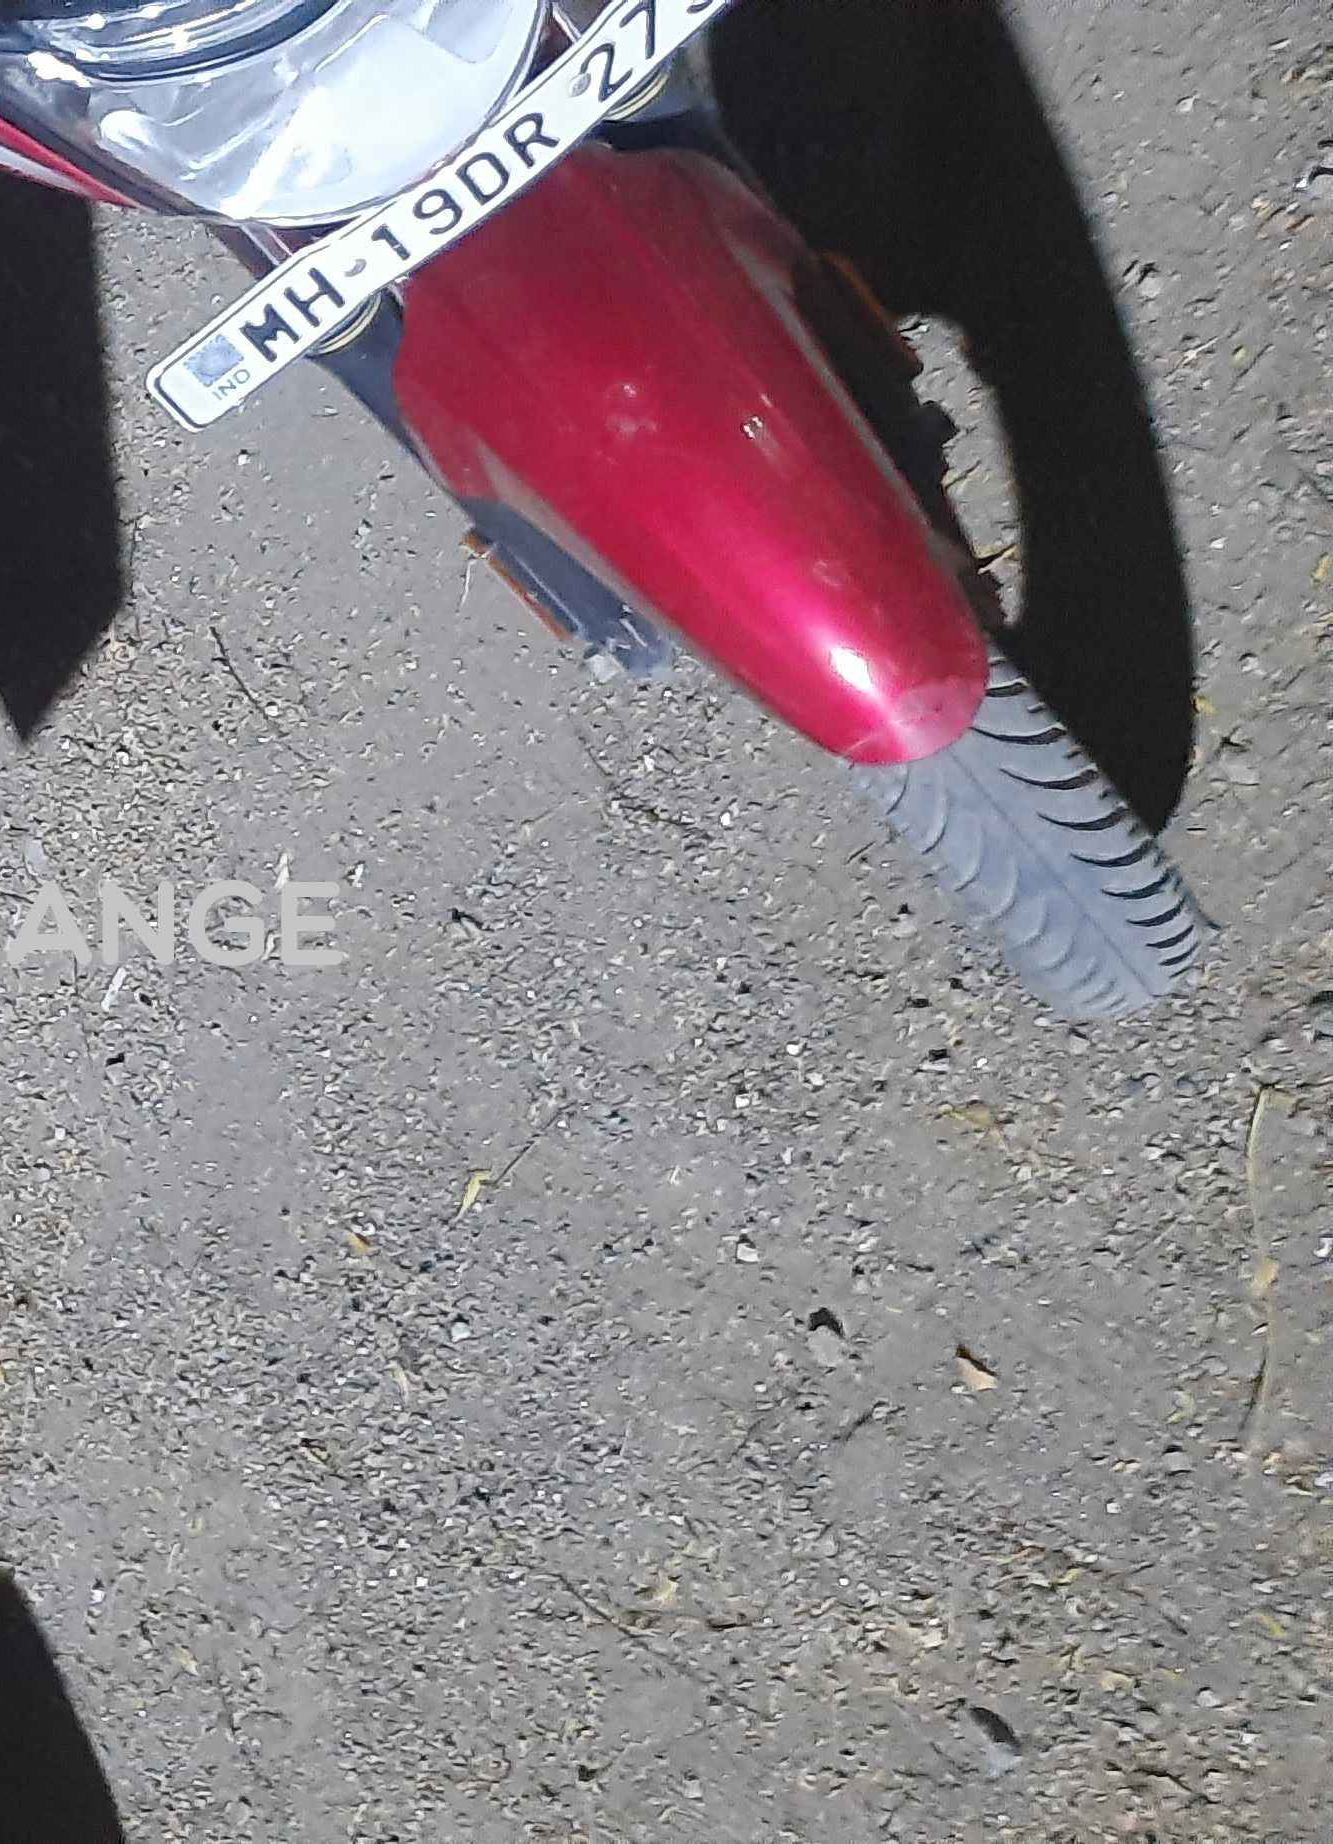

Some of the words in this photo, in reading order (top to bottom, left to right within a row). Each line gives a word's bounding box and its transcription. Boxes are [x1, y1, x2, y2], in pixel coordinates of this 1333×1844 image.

[240, 267, 345, 362] MH
[580, 0, 713, 101] 27
[211, 368, 251, 401] IND
